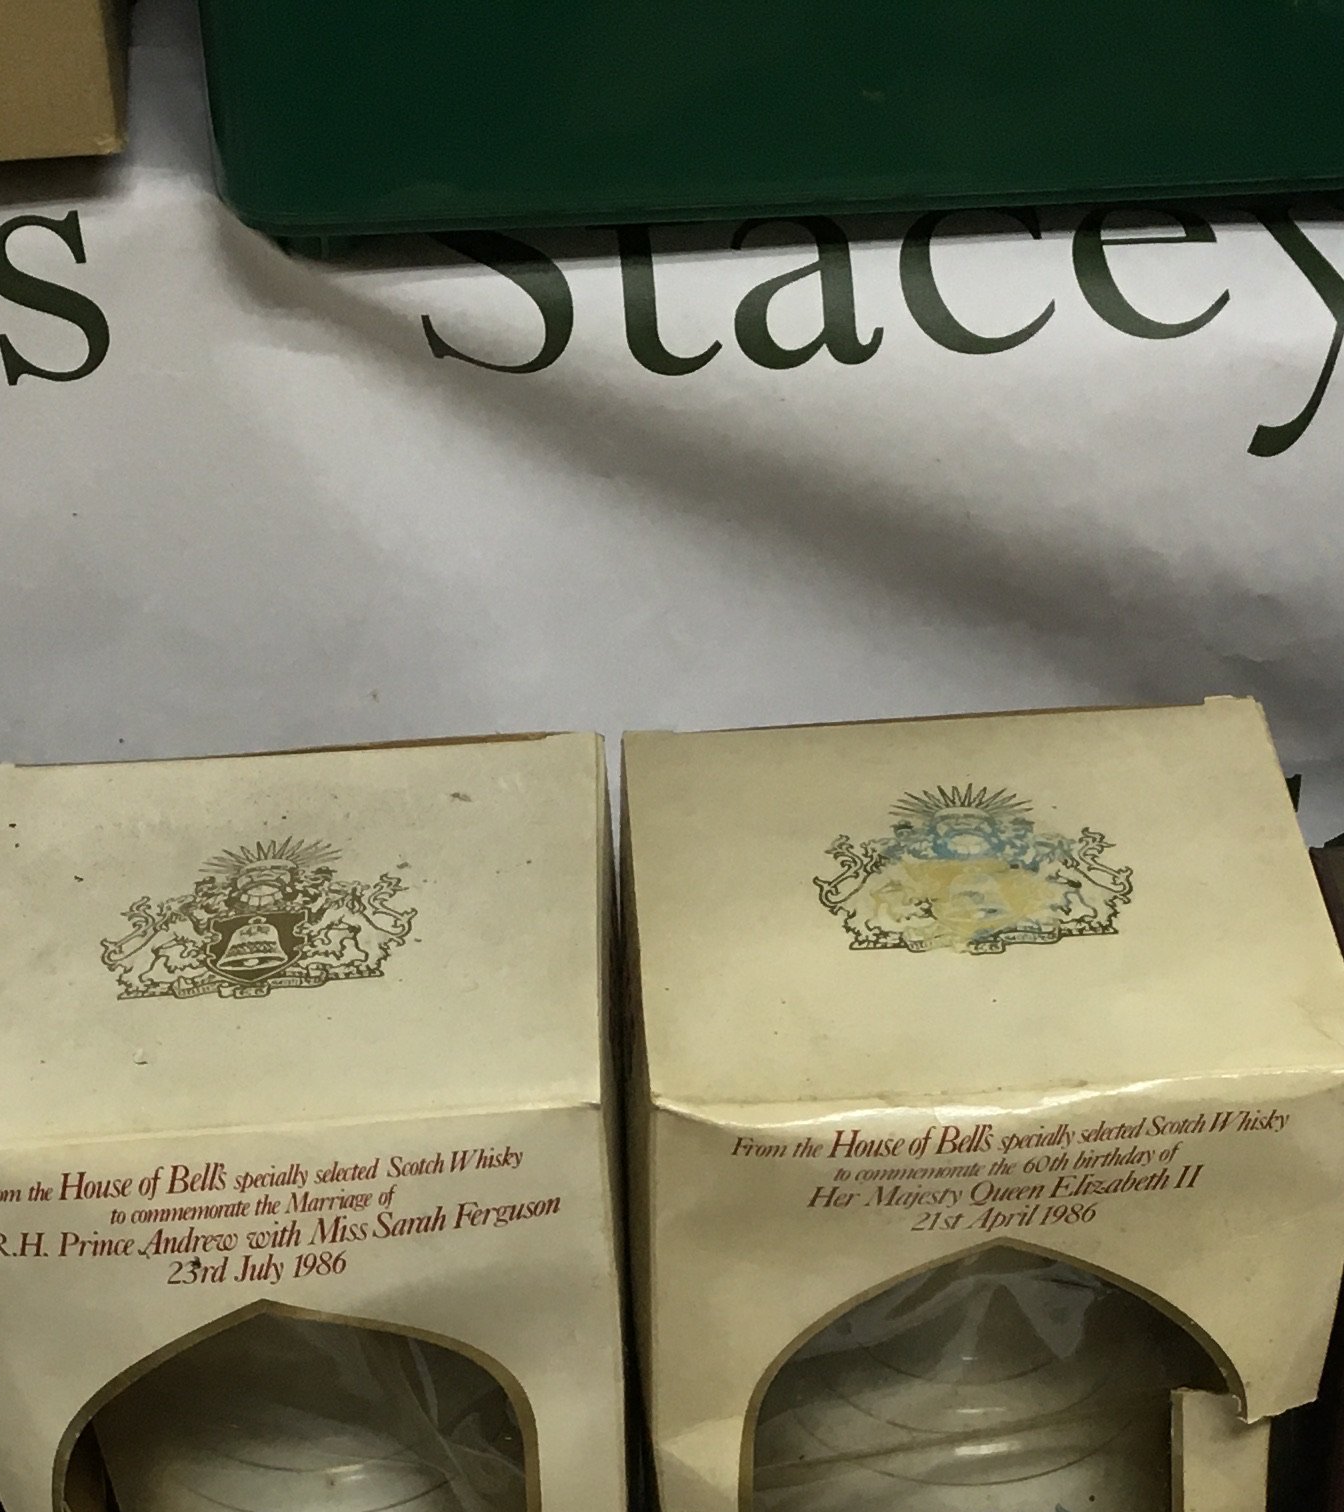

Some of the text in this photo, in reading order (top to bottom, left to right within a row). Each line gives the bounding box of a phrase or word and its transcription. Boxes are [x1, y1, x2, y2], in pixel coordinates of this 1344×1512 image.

[731, 1109, 1290, 1159] From the House of Bell's specially selected Scotch Whisky
[27, 1181, 54, 1202] the
[58, 1170, 133, 1201] House
[137, 1166, 162, 1199] of
[167, 1162, 228, 1195] Bell's
[234, 1162, 309, 1192] specially
[315, 1157, 378, 1185] selected
[386, 1153, 445, 1178] Scotch
[449, 1146, 524, 1175] Whisky
[833, 1141, 1180, 1183] to commemorate the 60th birthday of
[110, 1184, 395, 1226] to commemorate the Marriage of
[807, 1164, 1205, 1209] Her Majesty Queen Elizabeth II
[57, 1230, 135, 1257] Prince
[138, 1224, 238, 1260] Andrew
[247, 1220, 302, 1249] with
[308, 1214, 371, 1247] Miss
[373, 1205, 447, 1240] Sarah
[453, 1196, 562, 1231] Ferguson
[911, 1202, 1098, 1232] 21st April 1986
[167, 1250, 347, 1286] 23rd July 1986
